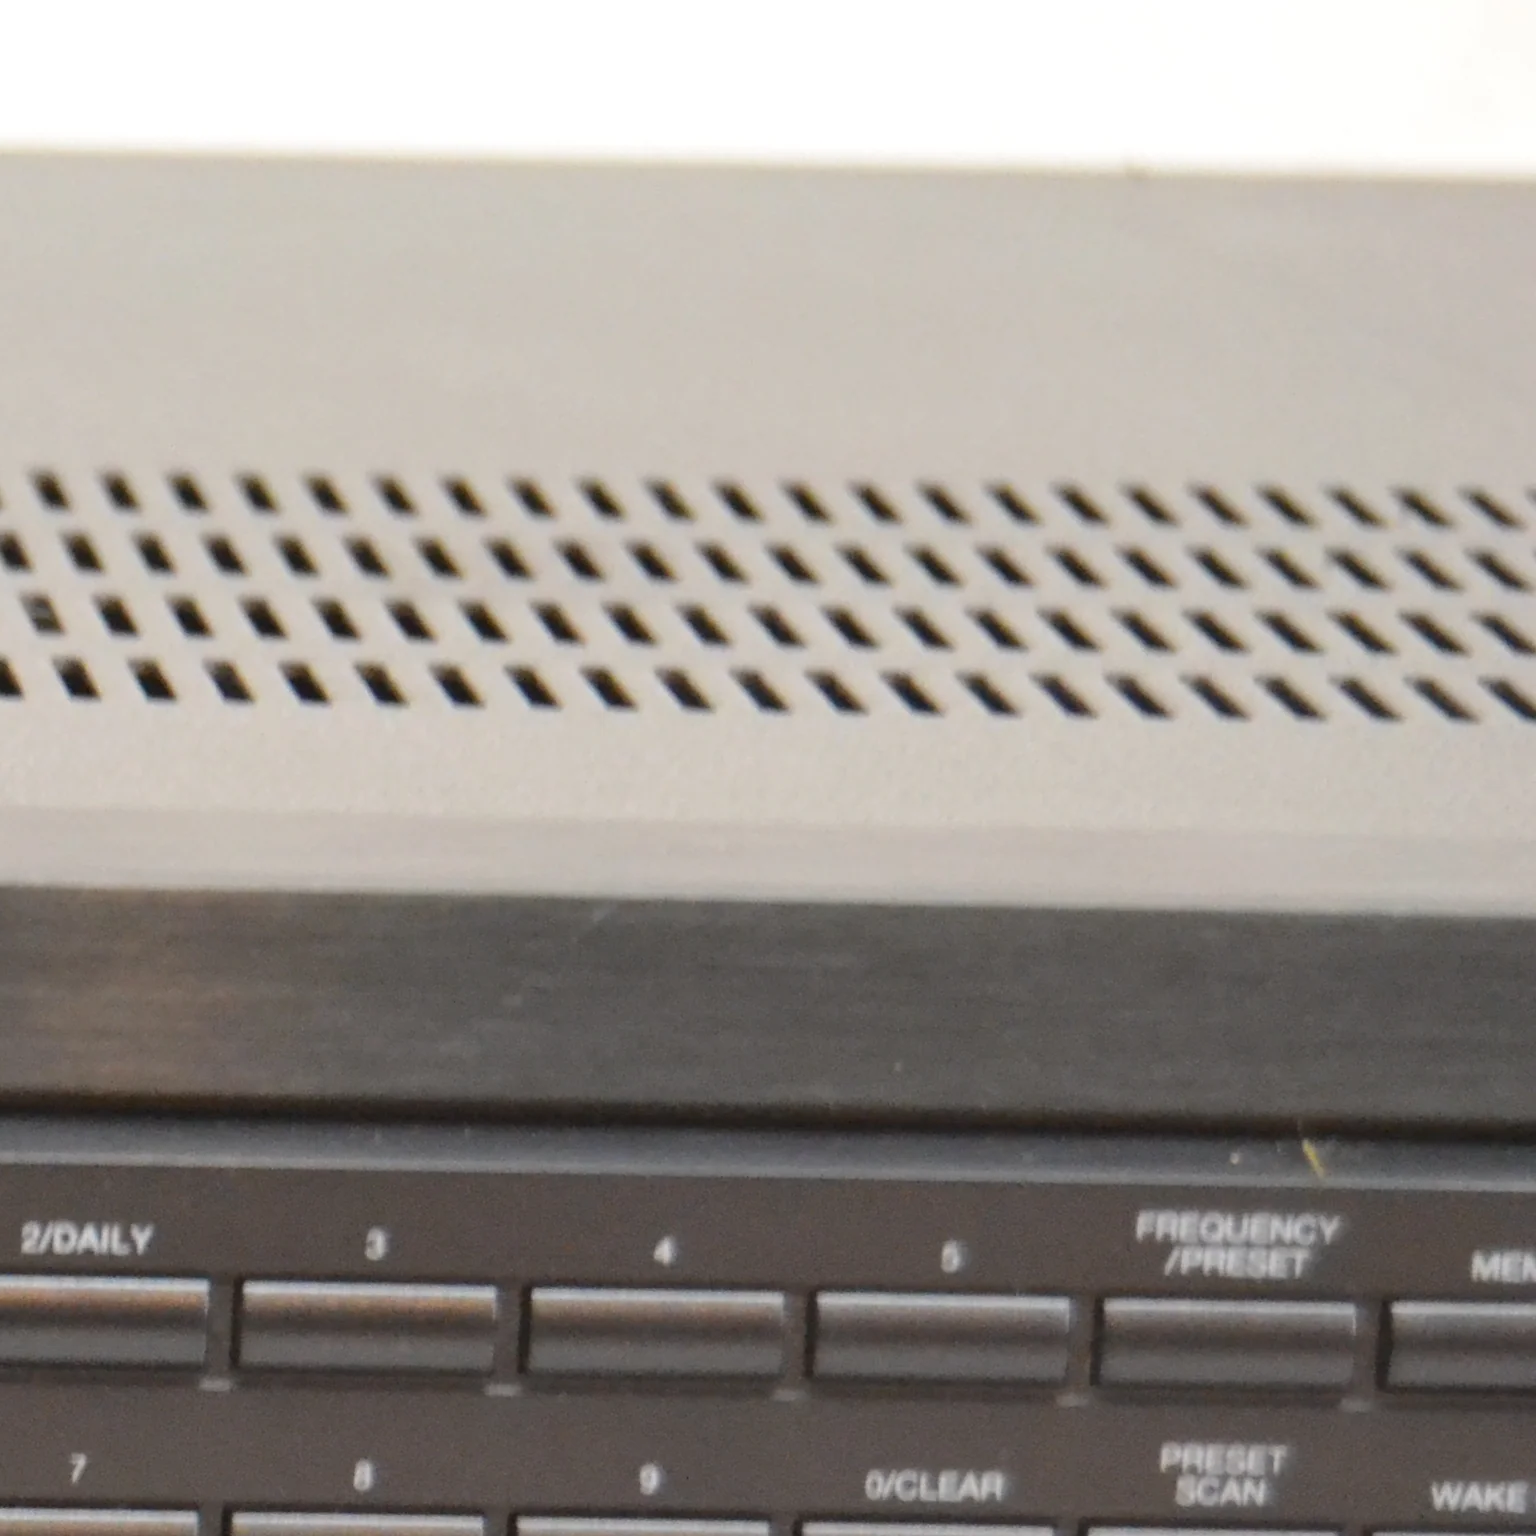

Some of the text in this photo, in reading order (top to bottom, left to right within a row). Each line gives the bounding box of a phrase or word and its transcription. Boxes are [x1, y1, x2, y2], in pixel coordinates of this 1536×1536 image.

[20, 1222, 155, 1256] 2/DAILY
[1135, 1210, 1340, 1244] FREQUENCY
[365, 1227, 388, 1261] 3
[653, 1236, 679, 1267] 4
[1164, 1246, 1310, 1279] /PRESET
[69, 1454, 89, 1485] 7
[1160, 1443, 1289, 1475] PRESET
[353, 1459, 375, 1492] 8
[640, 1464, 663, 1496] 9
[864, 1470, 1005, 1502] 0/CLEAR
[1175, 1477, 1268, 1508] SCAN
[1431, 1482, 1528, 1514] WAKE
